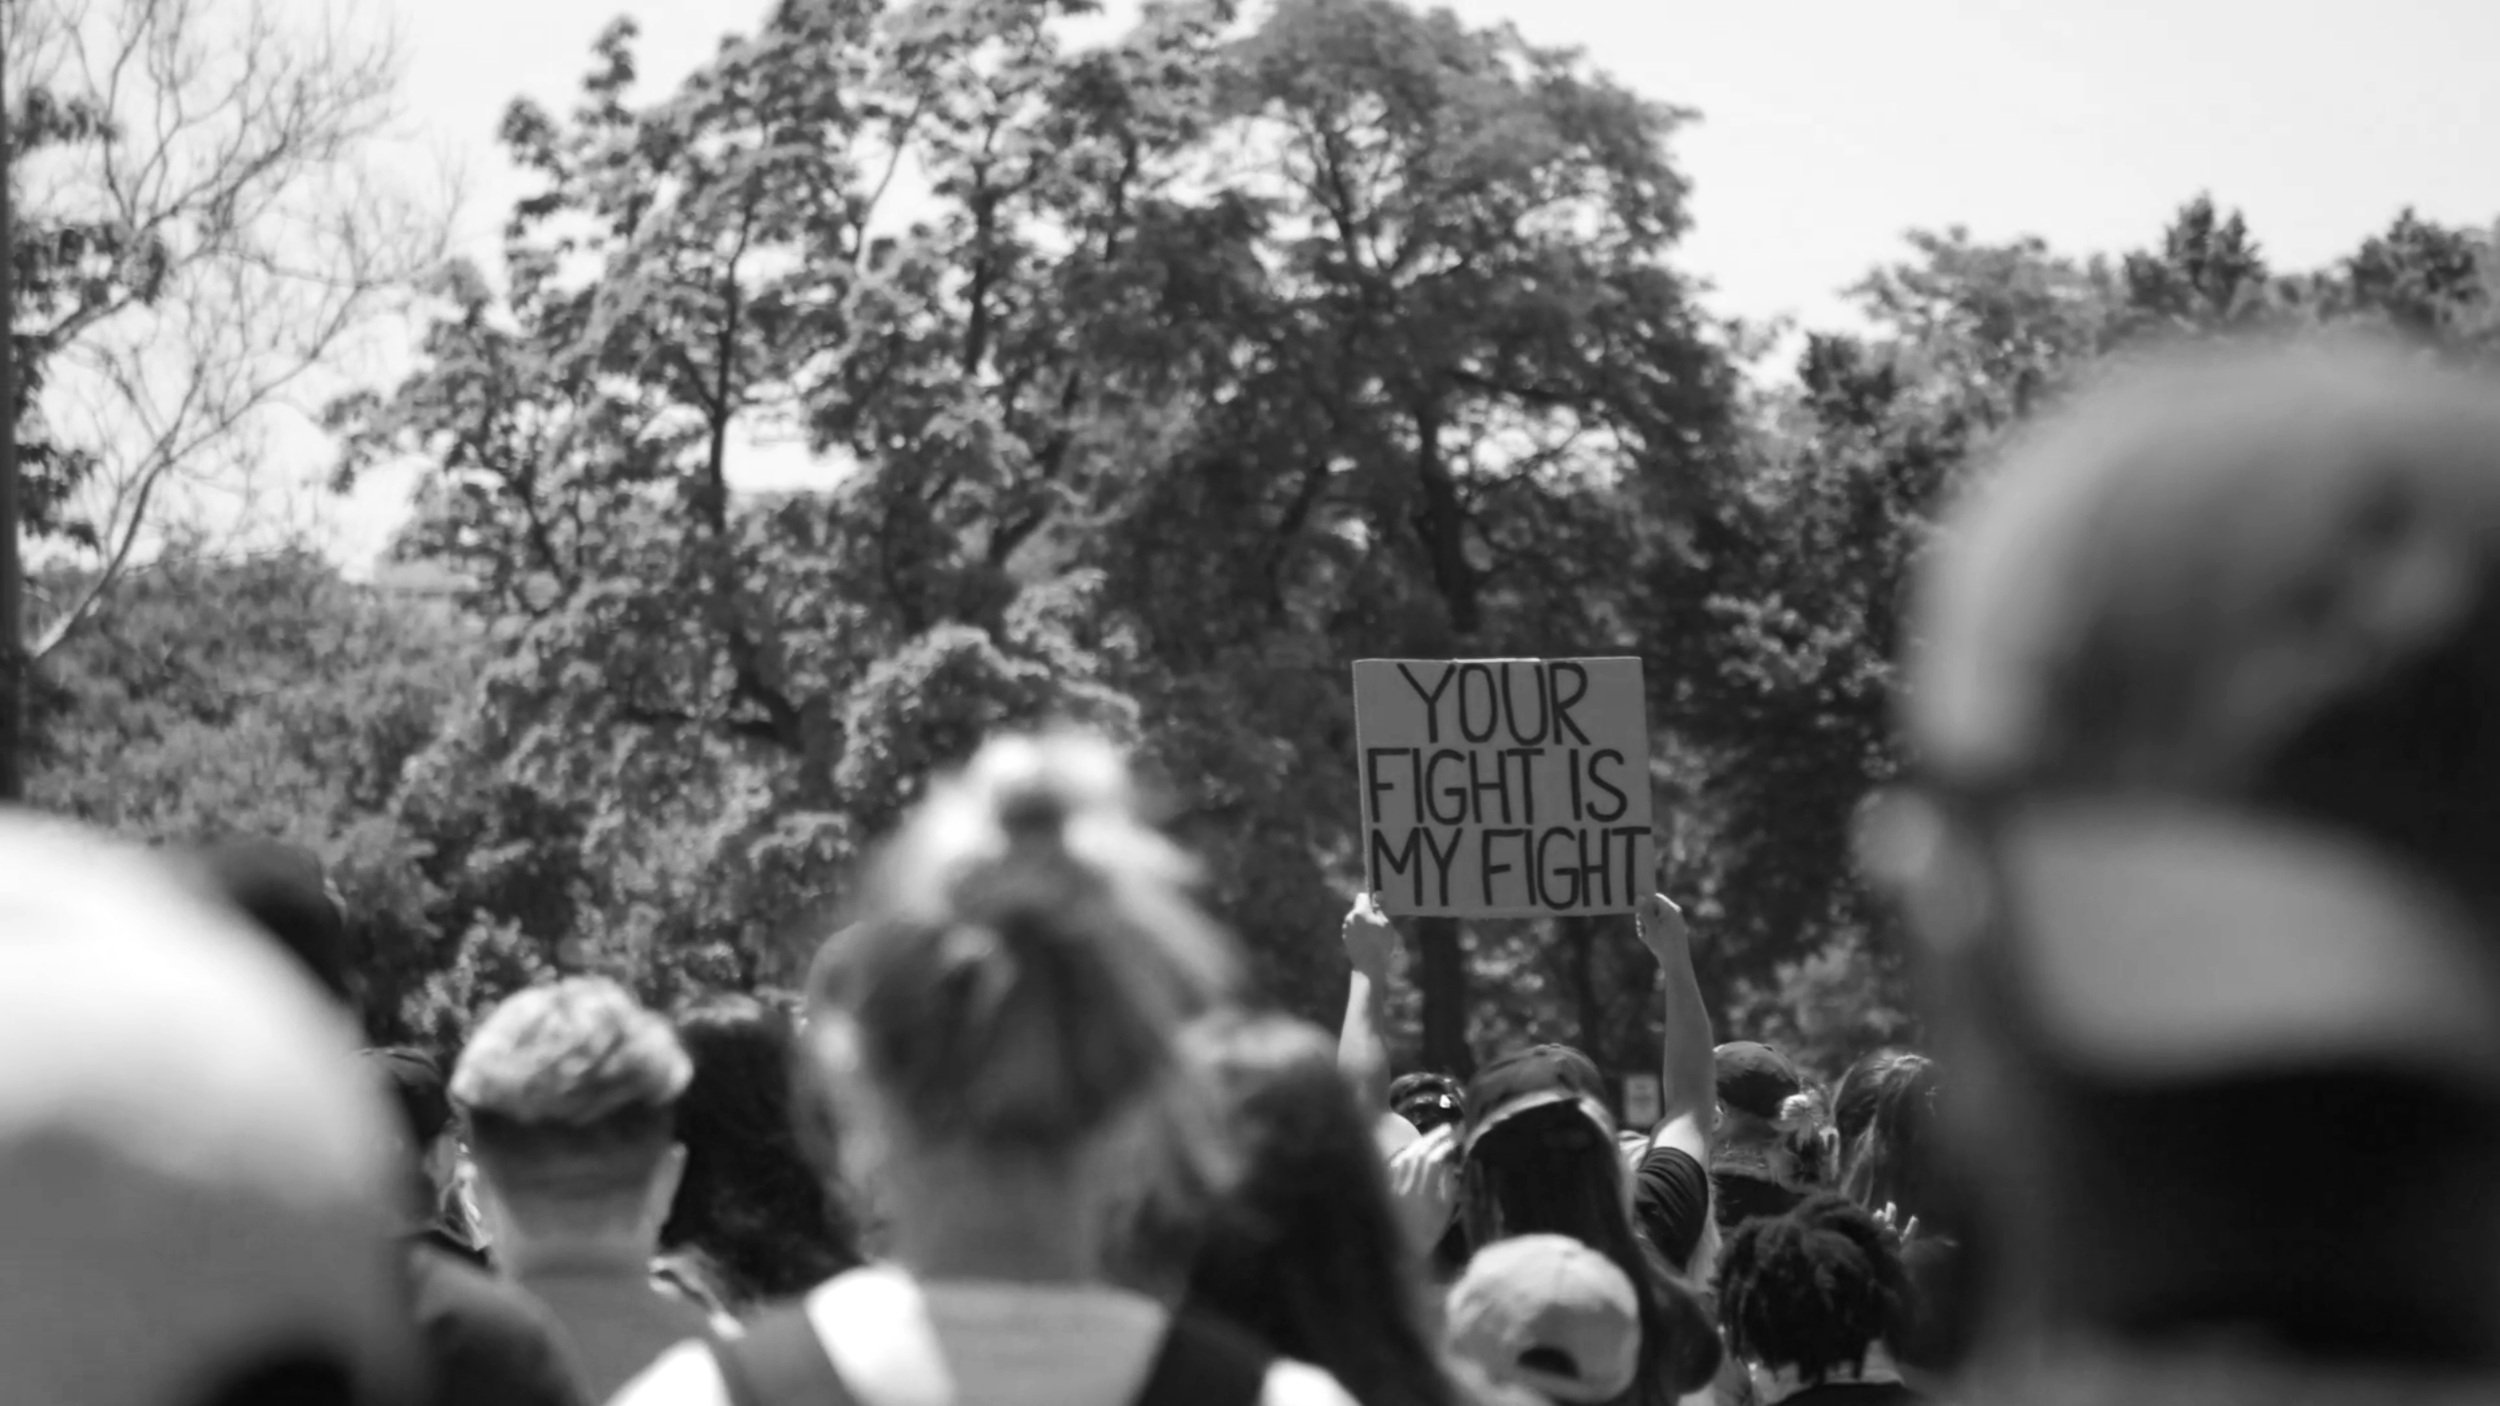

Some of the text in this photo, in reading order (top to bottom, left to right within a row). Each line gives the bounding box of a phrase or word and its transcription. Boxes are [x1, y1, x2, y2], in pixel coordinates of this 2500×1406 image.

[1397, 662, 1591, 746] YOUR
[1367, 747, 1628, 825] FIGHT IS
[1372, 826, 1652, 911] MY FIGHT
